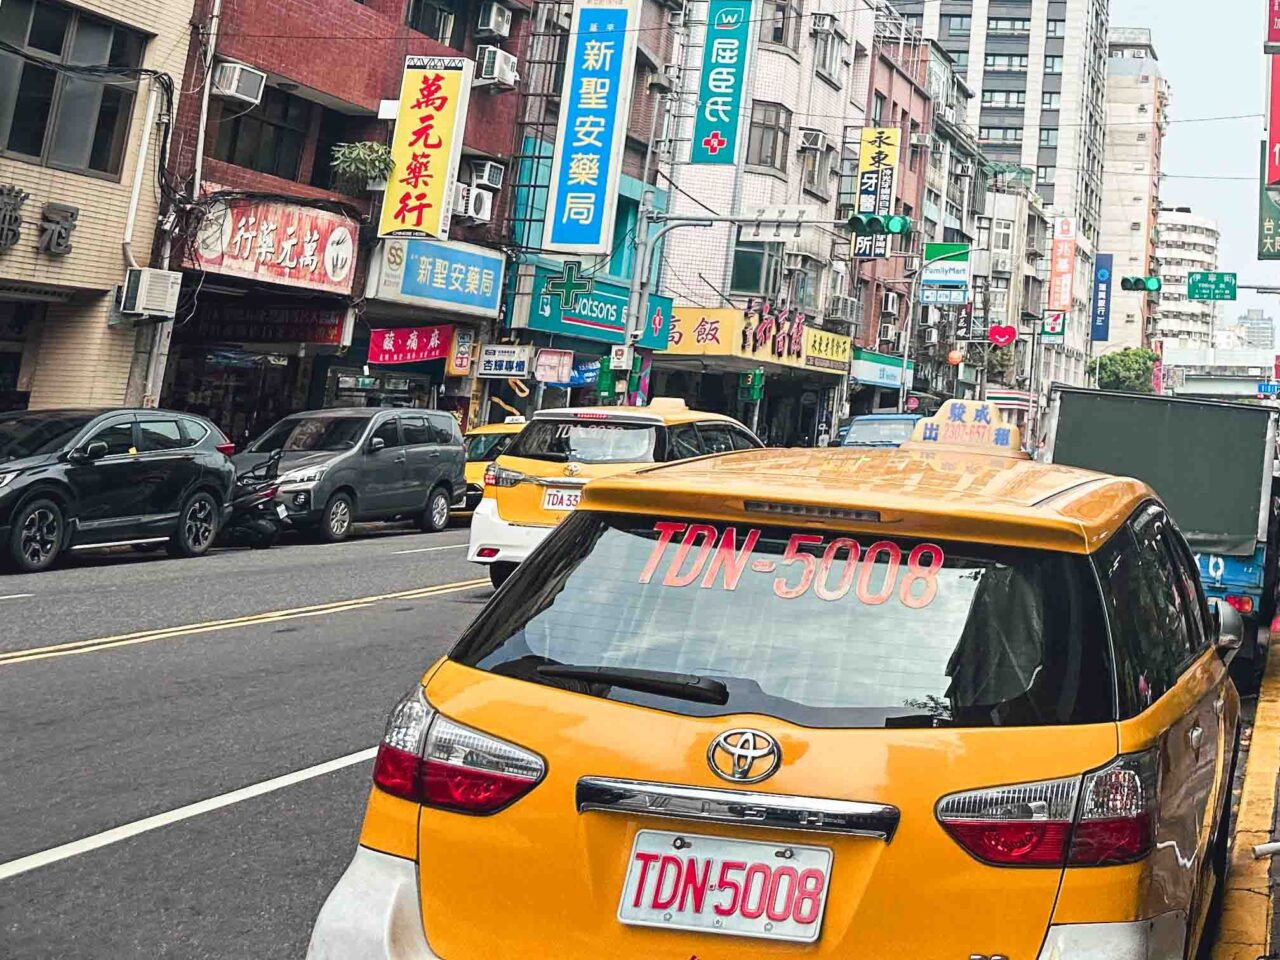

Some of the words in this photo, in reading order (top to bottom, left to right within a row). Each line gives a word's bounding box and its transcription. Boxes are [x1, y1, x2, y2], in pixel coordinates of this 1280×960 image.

[704, 38, 740, 123] 屈臣氏
[394, 73, 448, 227] 萬元藥行
[561, 39, 615, 226] 新聖安藥局
[868, 131, 896, 168] 永東
[855, 174, 878, 254] 牙醫所
[417, 254, 494, 297] 新聖安藥局
[925, 266, 966, 275] FamilyMart
[638, 521, 944, 608] TDN-5008
